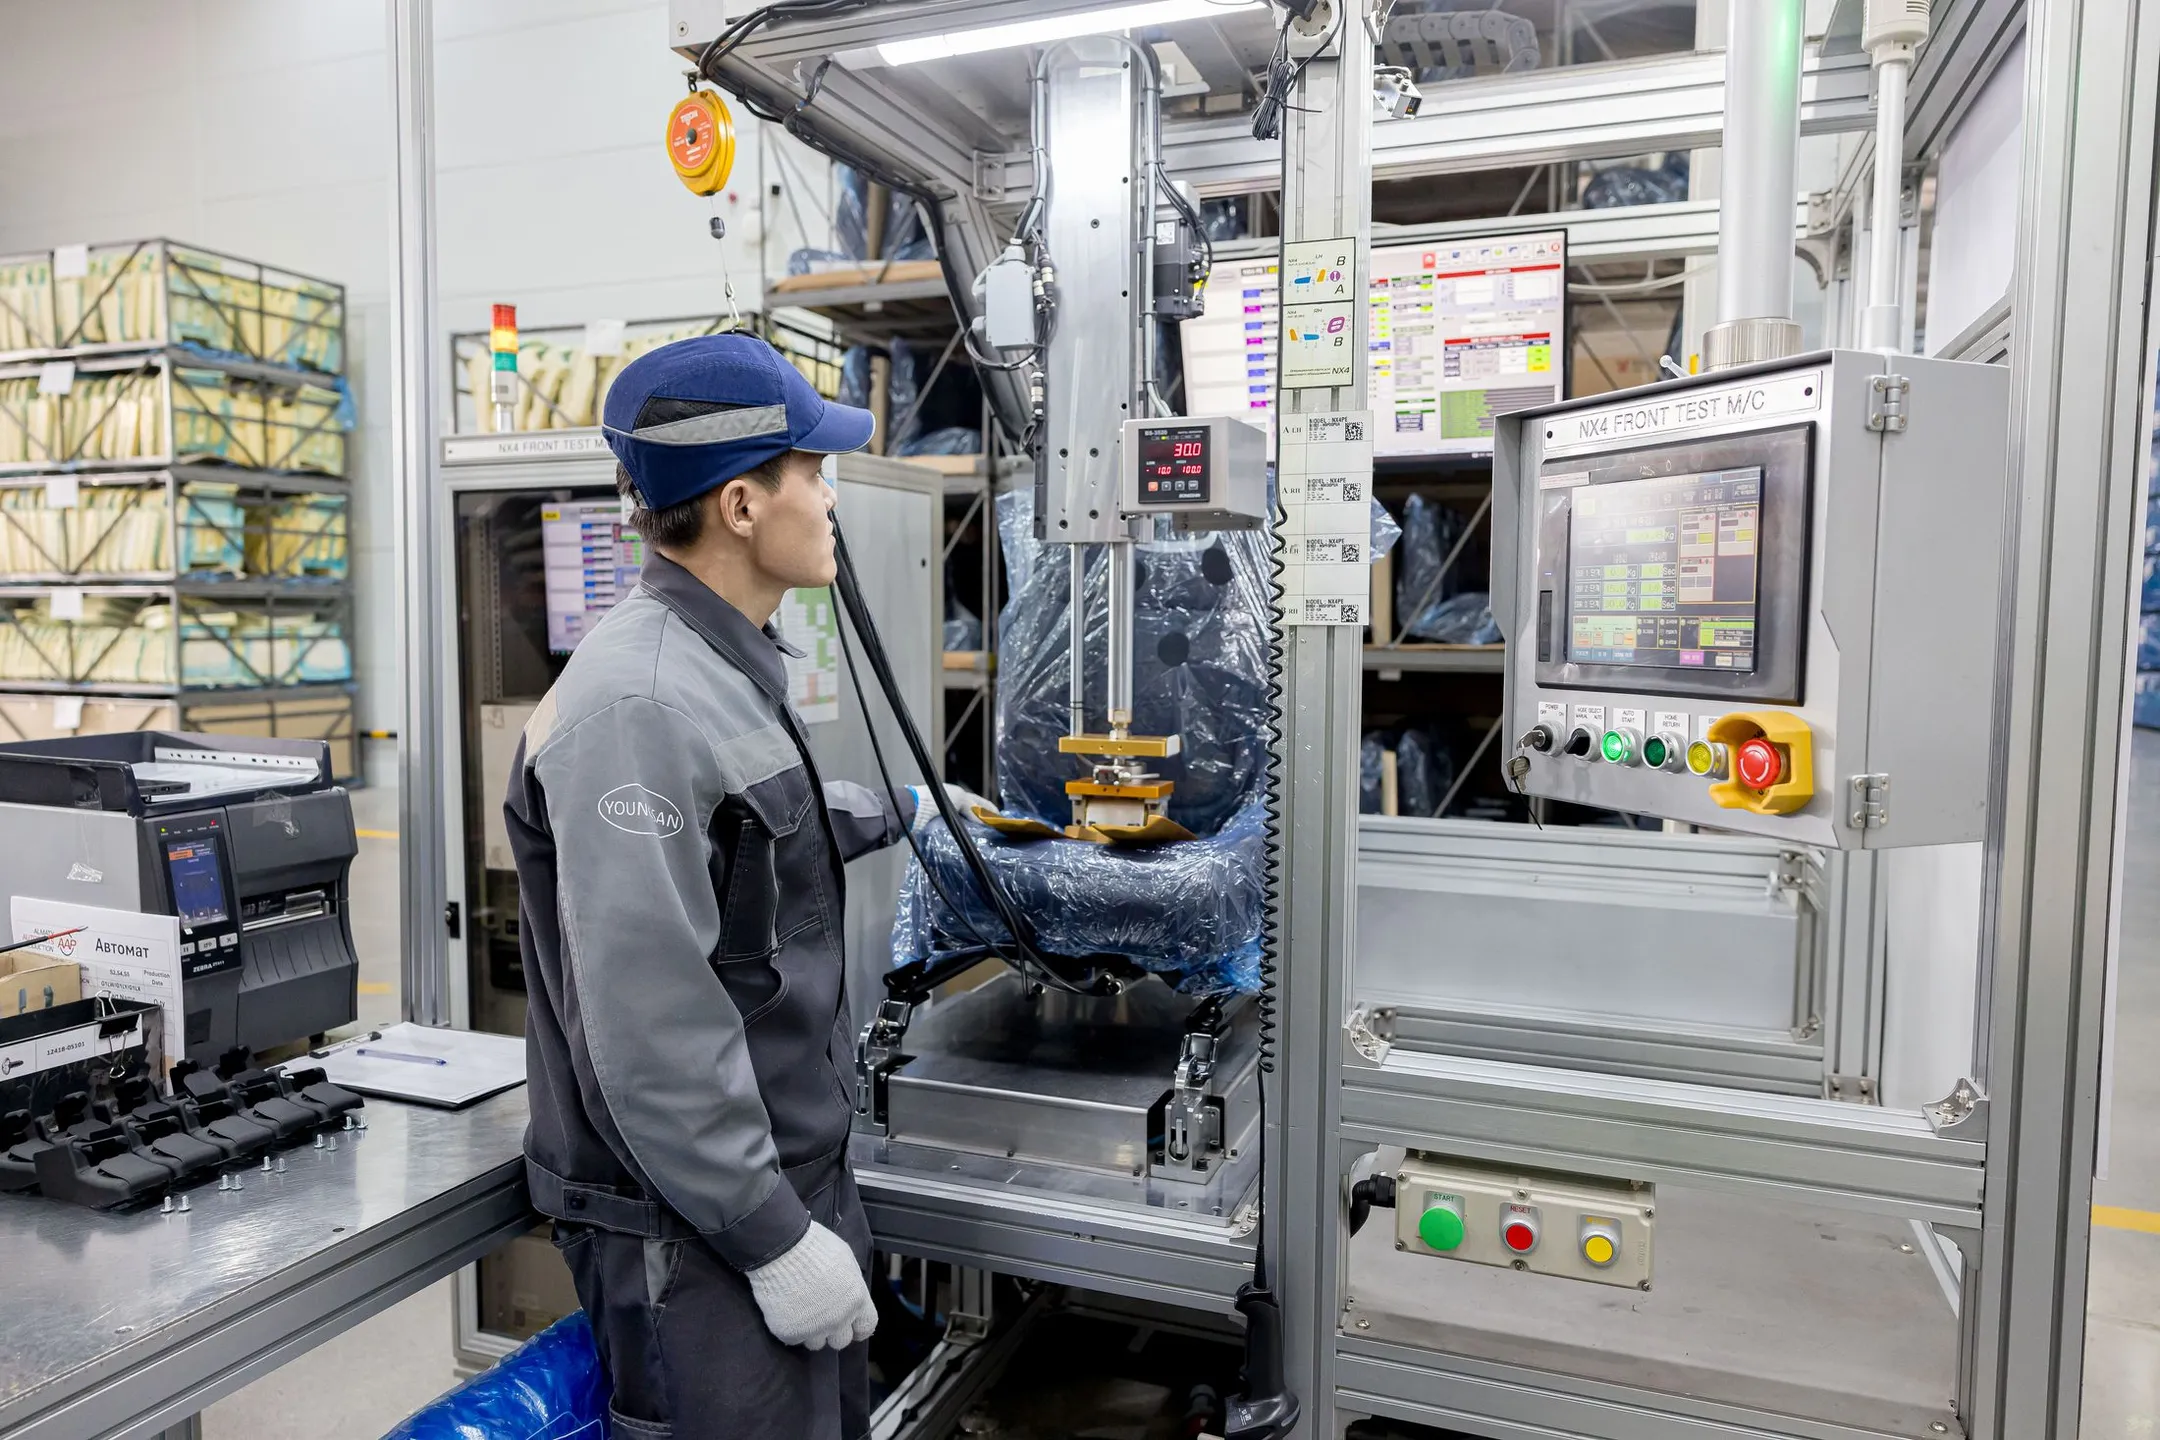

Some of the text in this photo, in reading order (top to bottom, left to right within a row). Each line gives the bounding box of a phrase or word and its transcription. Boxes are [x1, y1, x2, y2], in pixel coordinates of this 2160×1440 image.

[1336, 256, 1346, 266] B
[1334, 284, 1344, 294] A
[1333, 337, 1343, 347] B
[1332, 366, 1350, 375] NX4
[1579, 390, 1765, 438] NX4 FRONT TEST M/C
[498, 443, 519, 452] NX4
[523, 440, 558, 452] FRONT
[564, 439, 590, 450] TEST
[1174, 443, 1201, 457] 30.0
[95, 938, 150, 959] Автомат
[143, 970, 171, 979] Production
[151, 979, 163, 987] Date
[1433, 1193, 1455, 1202] START
[1510, 1204, 1532, 1214] RESET
